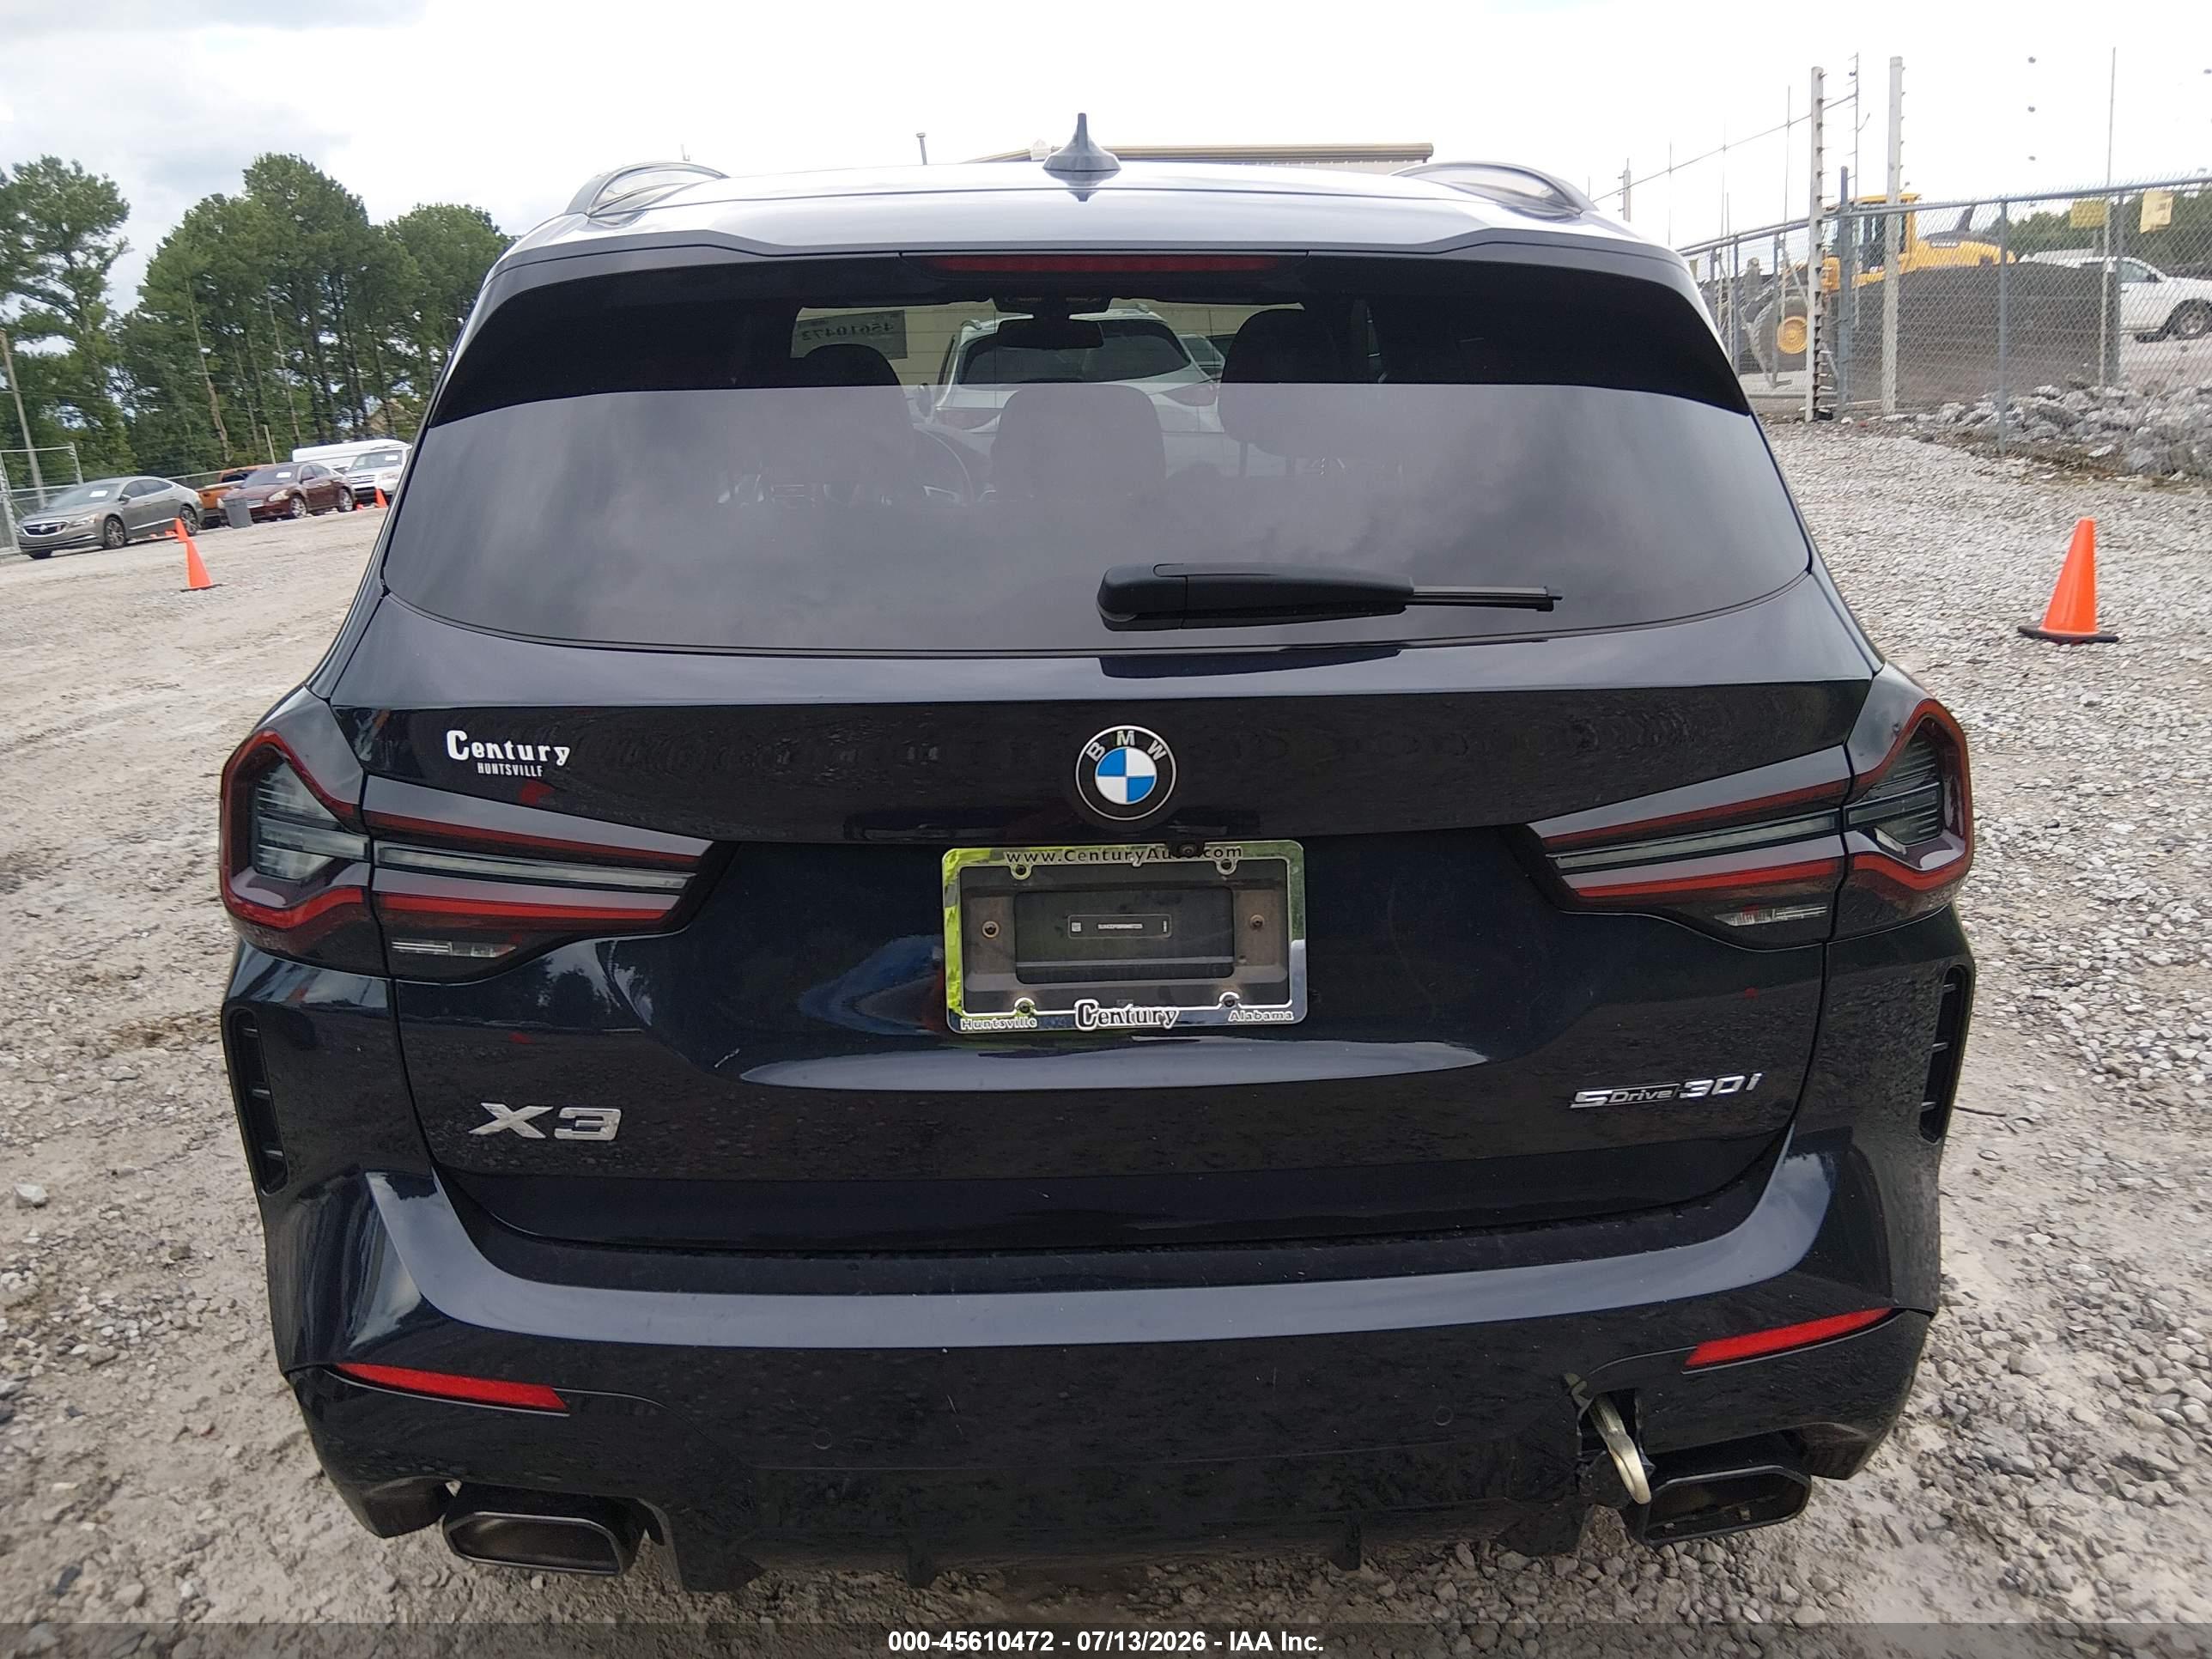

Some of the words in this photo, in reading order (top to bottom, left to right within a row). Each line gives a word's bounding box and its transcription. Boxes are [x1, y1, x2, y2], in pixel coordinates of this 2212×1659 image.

[447, 730, 570, 766] Century
[1085, 730, 1168, 762] BMW
[1006, 846, 1243, 865] www.CenturyAucom
[960, 1017, 1038, 1030] Huntsville
[1074, 1000, 1180, 1030] Century
[1228, 1010, 1294, 1022] Alabama
[468, 1102, 622, 1141] X3
